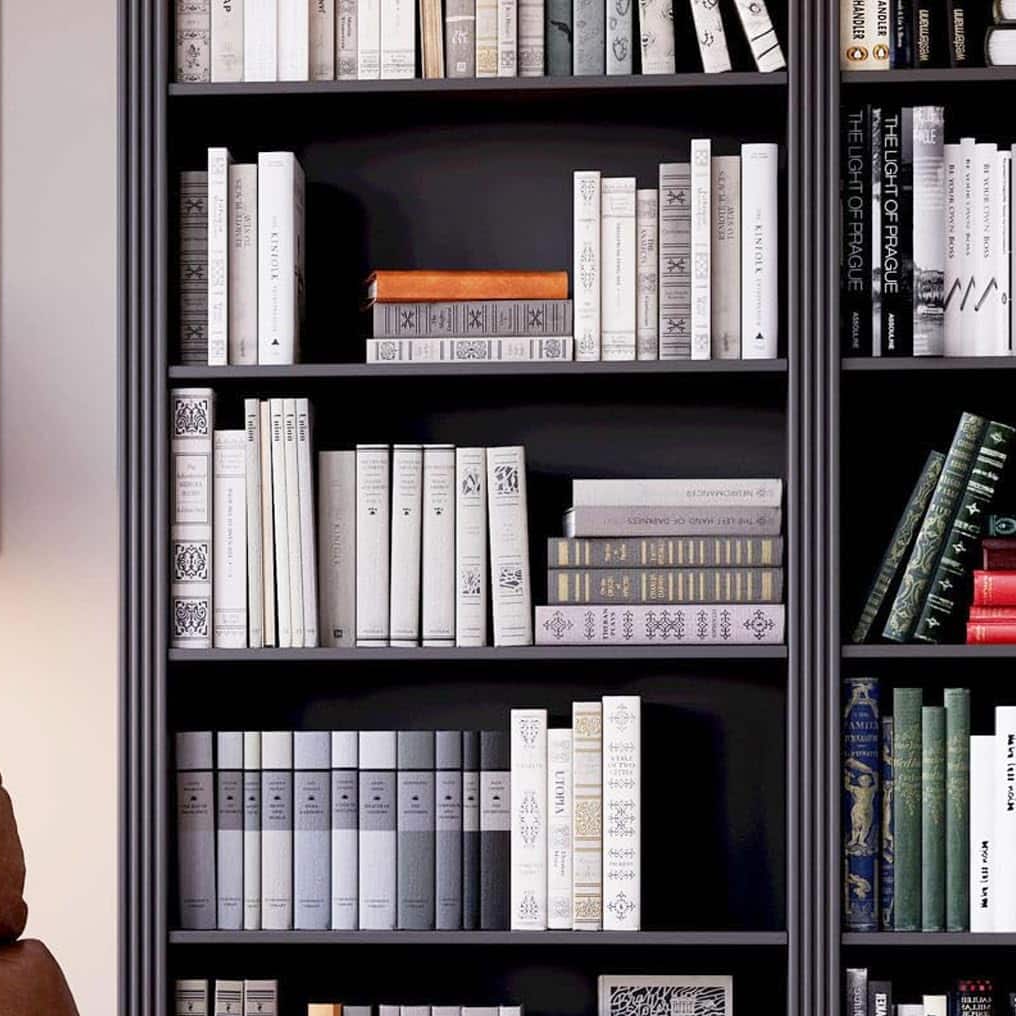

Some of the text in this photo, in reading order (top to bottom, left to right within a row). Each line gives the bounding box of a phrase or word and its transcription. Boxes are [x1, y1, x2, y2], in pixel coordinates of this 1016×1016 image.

[948, 163, 955, 174] BE
[848, 109, 863, 292] THE LIGHT OF PRAGUE
[884, 114, 899, 294] THE LIGHT OF PRAGUE
[754, 224, 763, 274] KINFOLK
[887, 312, 895, 351] ASSOULINE
[689, 517, 715, 526] HAND
[738, 517, 753, 526] THE
[554, 771, 565, 815] UTOPIA
